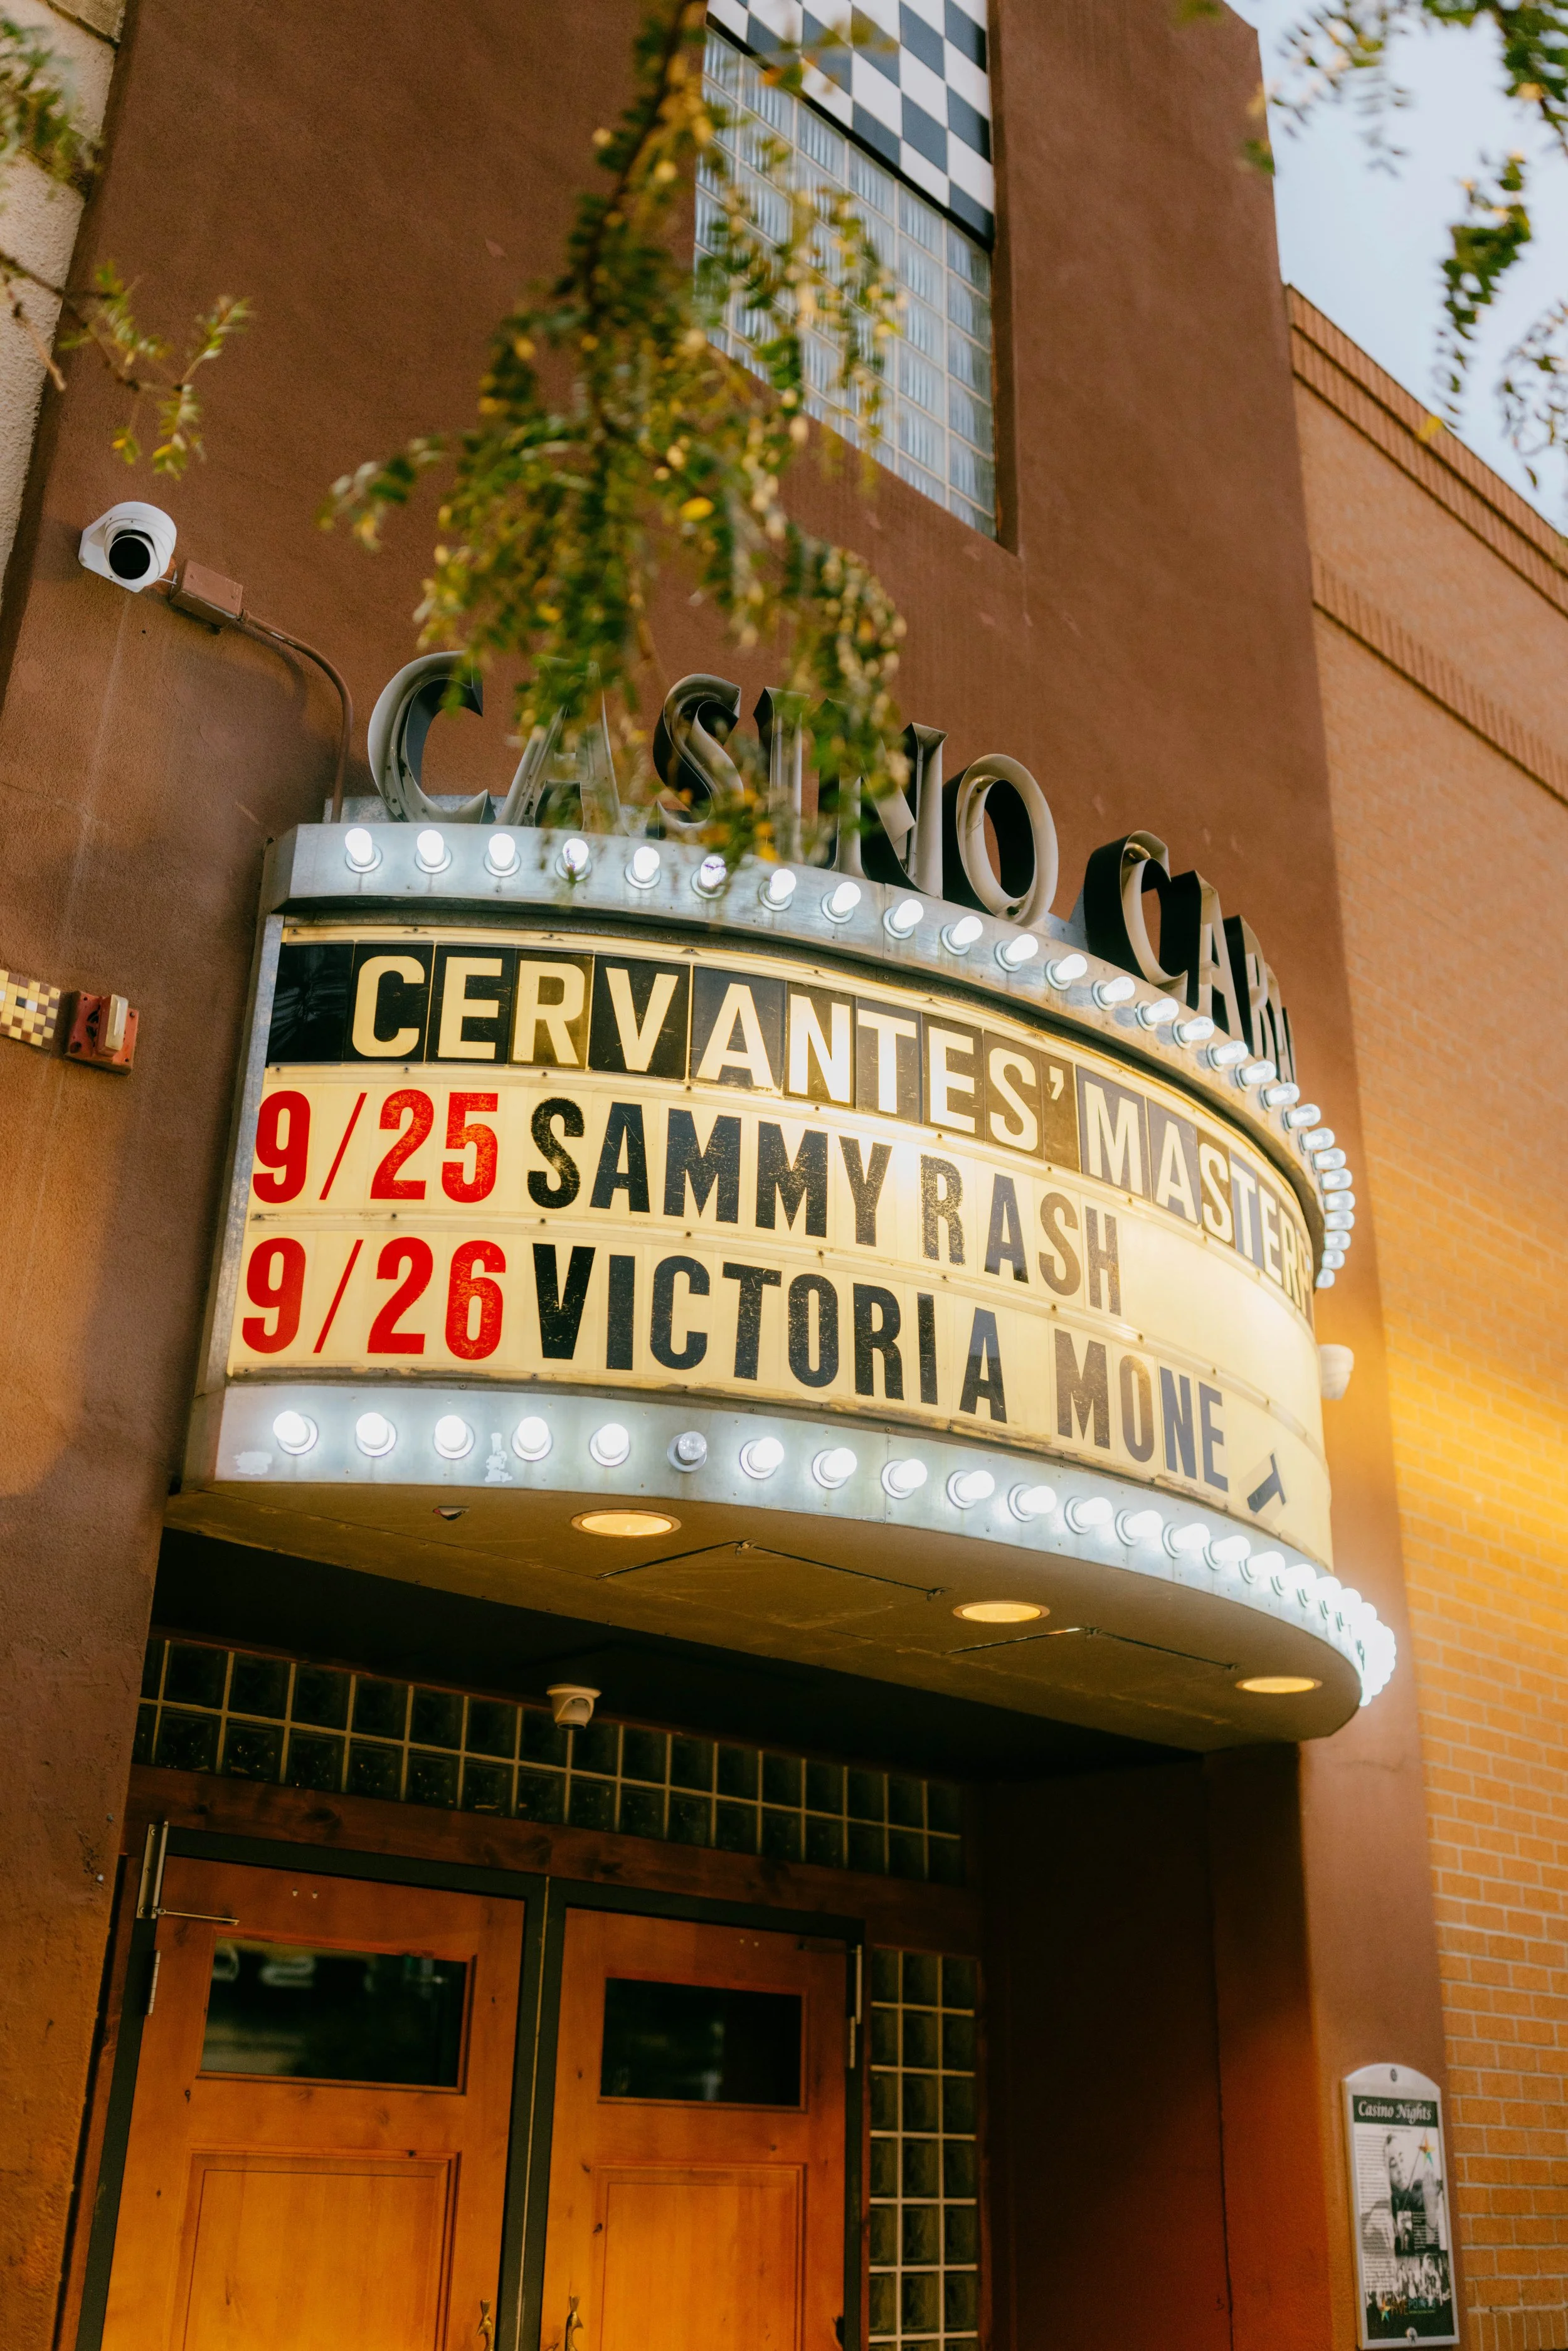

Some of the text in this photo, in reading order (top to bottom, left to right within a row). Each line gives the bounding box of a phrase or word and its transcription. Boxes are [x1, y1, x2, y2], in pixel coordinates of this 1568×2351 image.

[368, 650, 1059, 927] CASINO
[352, 955, 1063, 1152] CERVANTES'
[253, 1089, 1121, 1316] 9/25 SAMMY RASH
[241, 1237, 506, 1361] 9/26
[532, 1243, 1007, 1424] VICTORIA
[1358, 2100, 1432, 2125] Casino Nights
